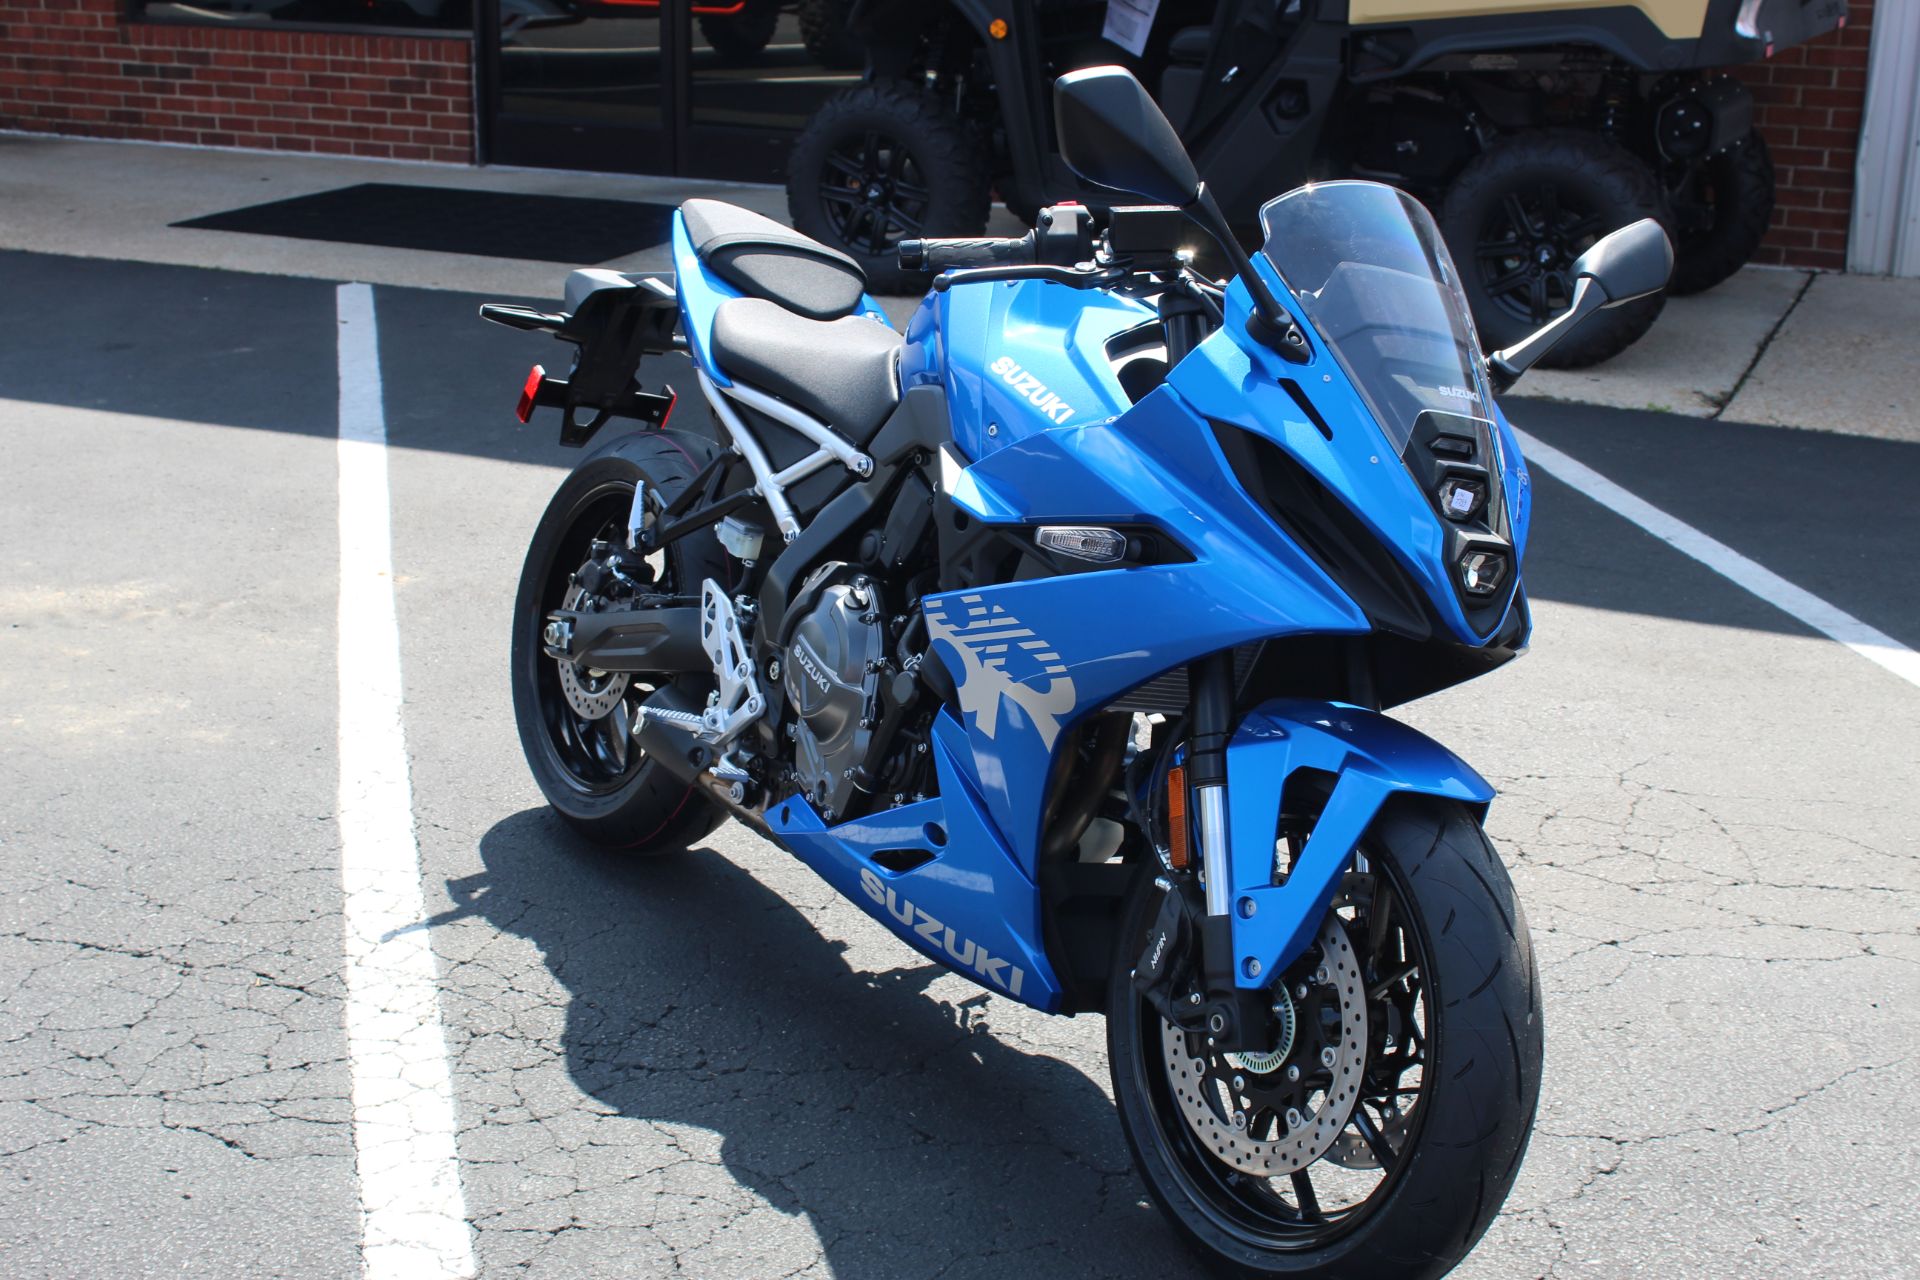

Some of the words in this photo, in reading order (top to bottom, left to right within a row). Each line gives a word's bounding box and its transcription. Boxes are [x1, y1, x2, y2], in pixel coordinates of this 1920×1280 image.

[991, 356, 1075, 425] SUZUKI
[1438, 385, 1480, 403] SUZUKI
[793, 644, 831, 694] SUZUKI
[860, 867, 1024, 997] SUZUKI
